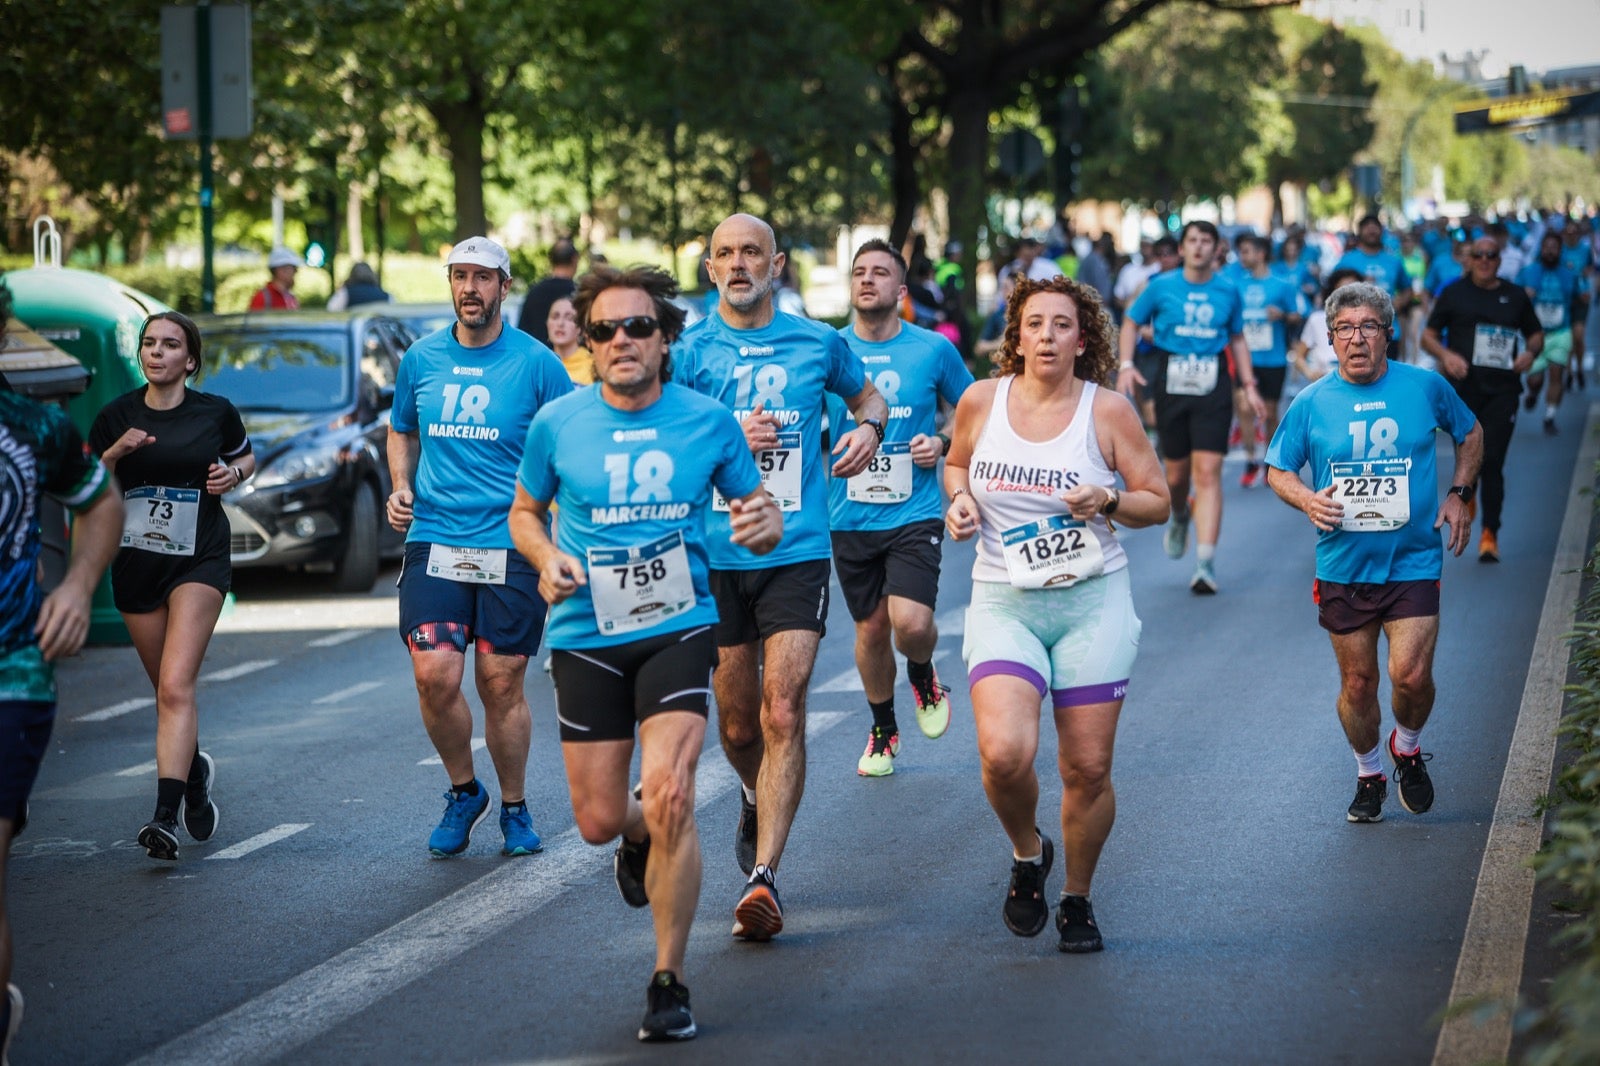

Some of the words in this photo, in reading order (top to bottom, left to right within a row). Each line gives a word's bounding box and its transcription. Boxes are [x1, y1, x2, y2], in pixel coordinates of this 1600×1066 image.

[733, 364, 787, 408] 18
[441, 384, 490, 425] 18
[428, 423, 500, 441] MARCELINO
[1348, 417, 1399, 460] 18
[604, 449, 674, 504] 18
[868, 457, 891, 472] 83
[974, 461, 1080, 490] RUNNER'S
[1343, 478, 1397, 496] 2273
[148, 499, 173, 520] 73
[591, 503, 690, 525] MARCELINO
[148, 518, 170, 527] LETICIA
[1019, 529, 1086, 564] 1822
[1052, 558, 1066, 566] DEL
[1066, 551, 1082, 561] MAR
[613, 558, 667, 590] 758
